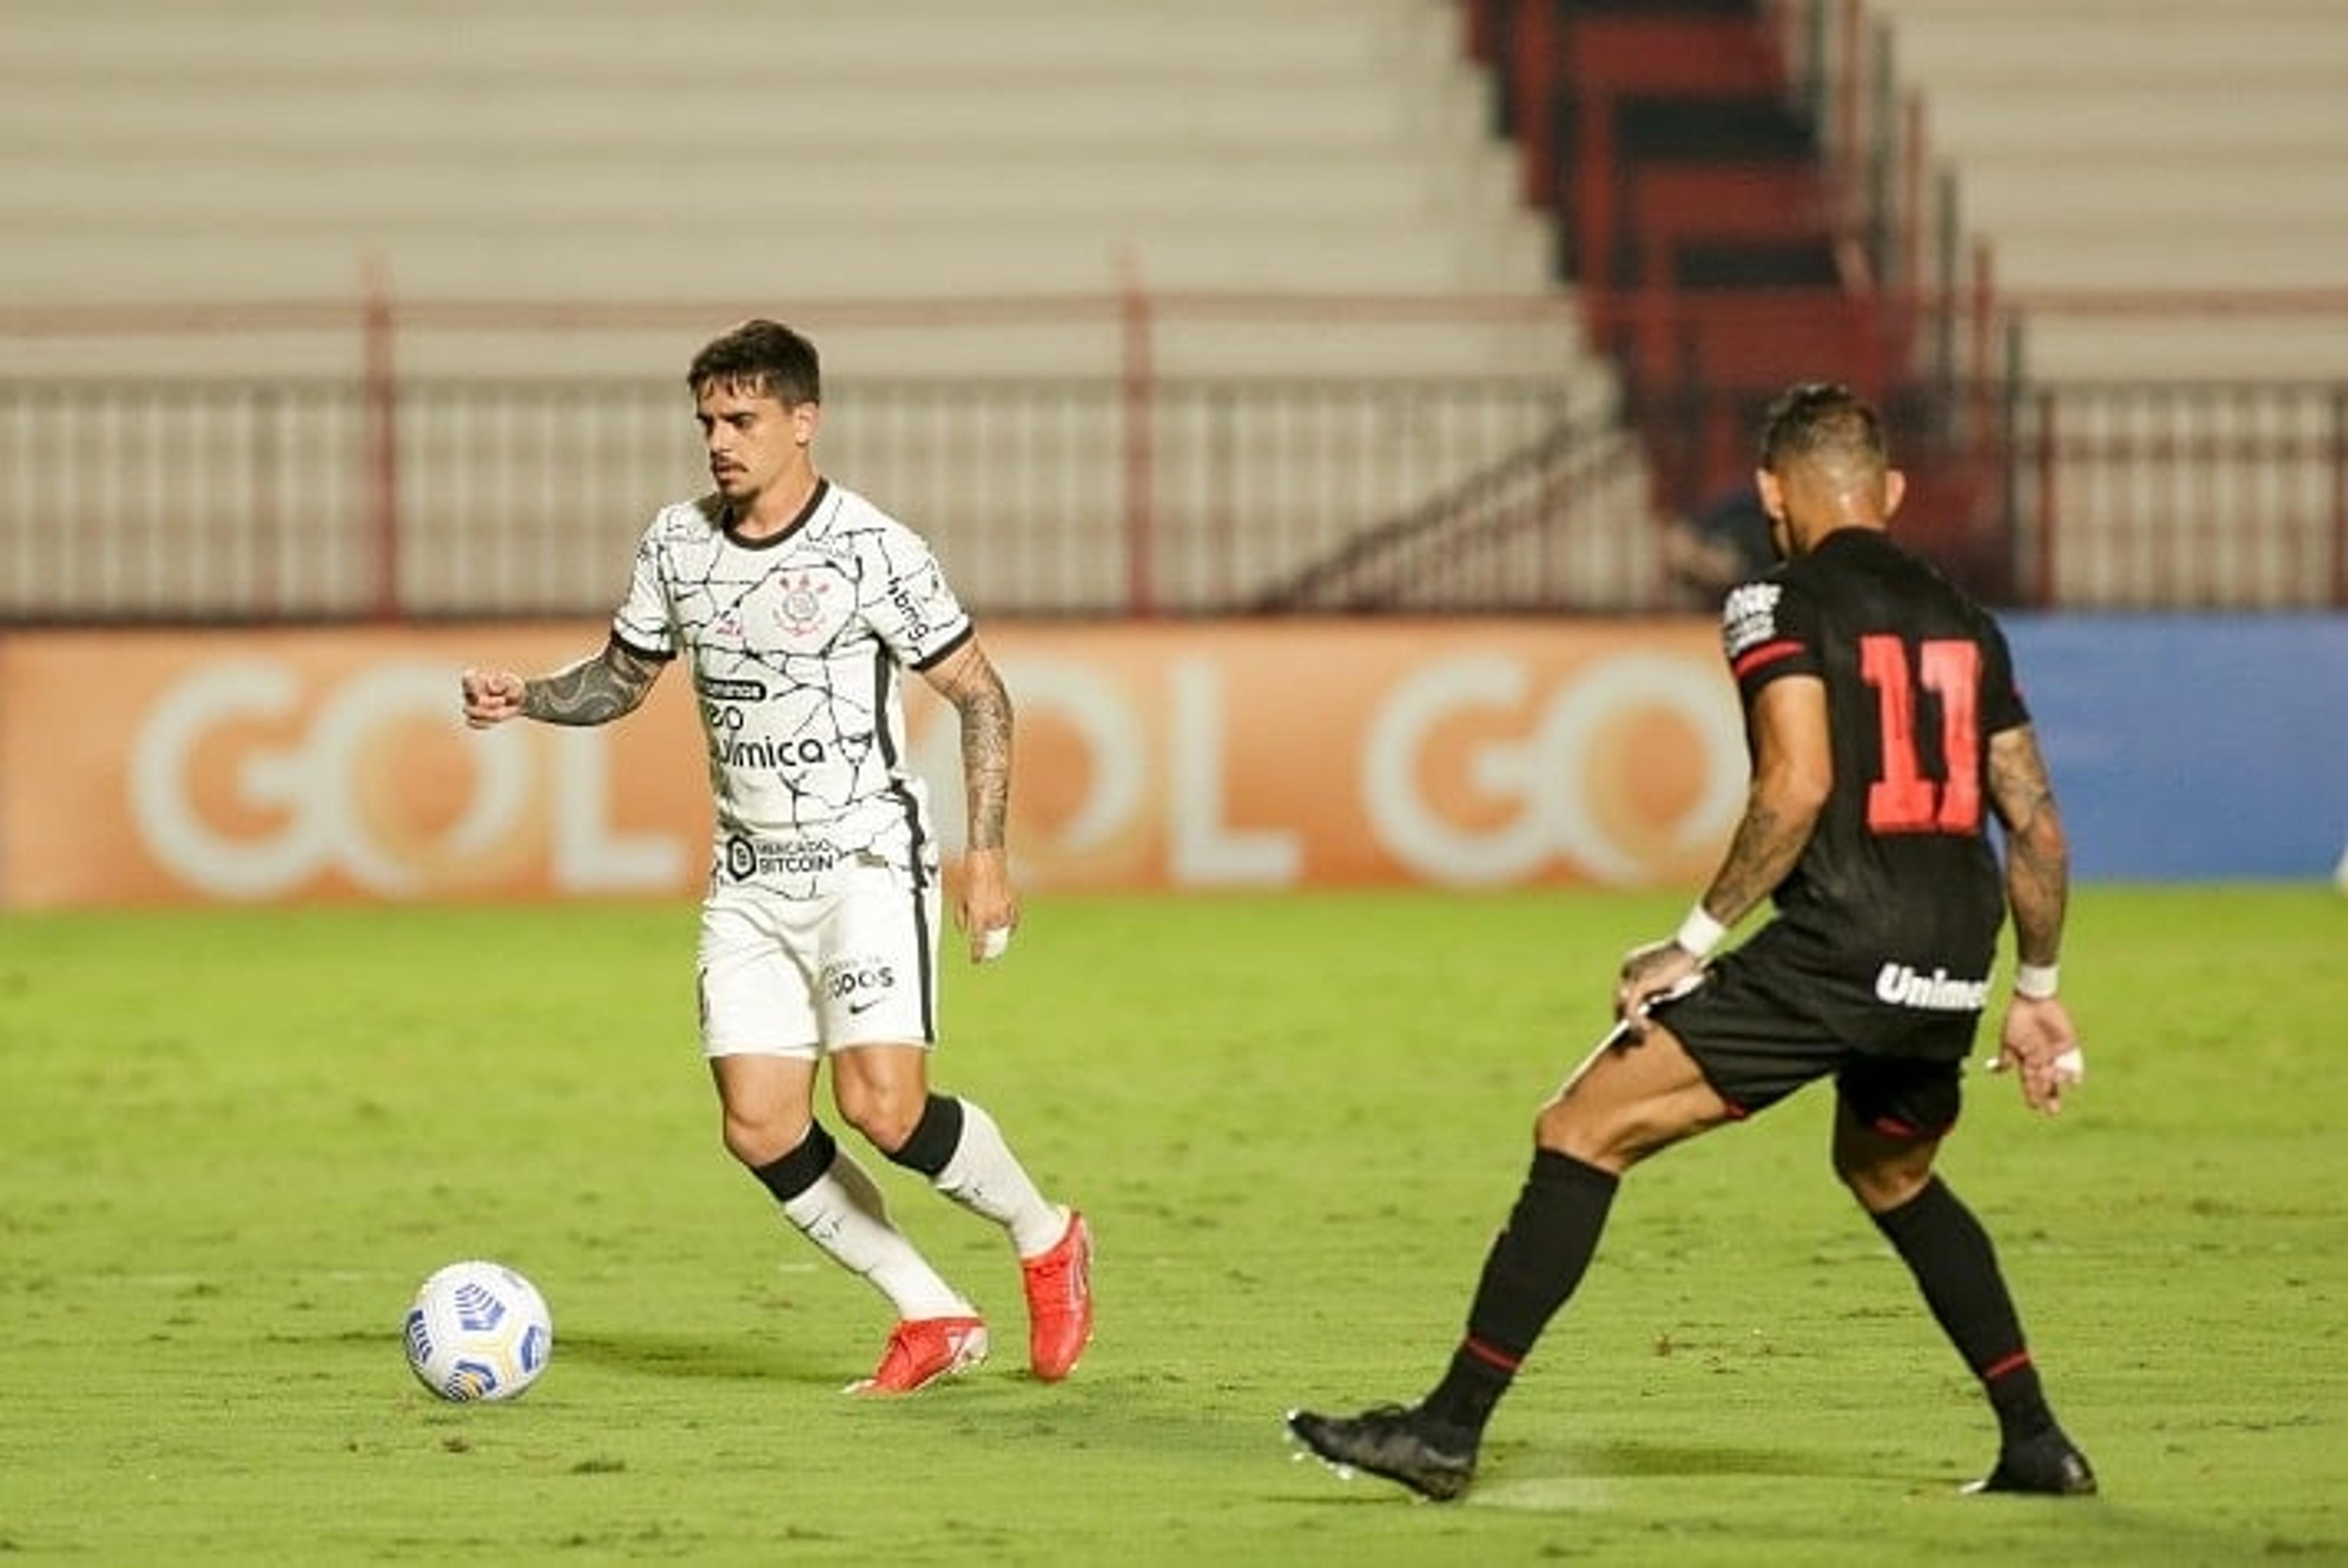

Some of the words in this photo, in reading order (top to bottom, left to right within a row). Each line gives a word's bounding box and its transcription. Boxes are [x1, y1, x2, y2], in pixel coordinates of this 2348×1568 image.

[133, 658, 685, 897] GOL
[906, 654, 1304, 886] OL
[1365, 652, 1751, 885] GO
[1860, 633, 1982, 835] 11
[759, 855, 833, 875] BITCOIN
[1875, 962, 1987, 1011] Unime
